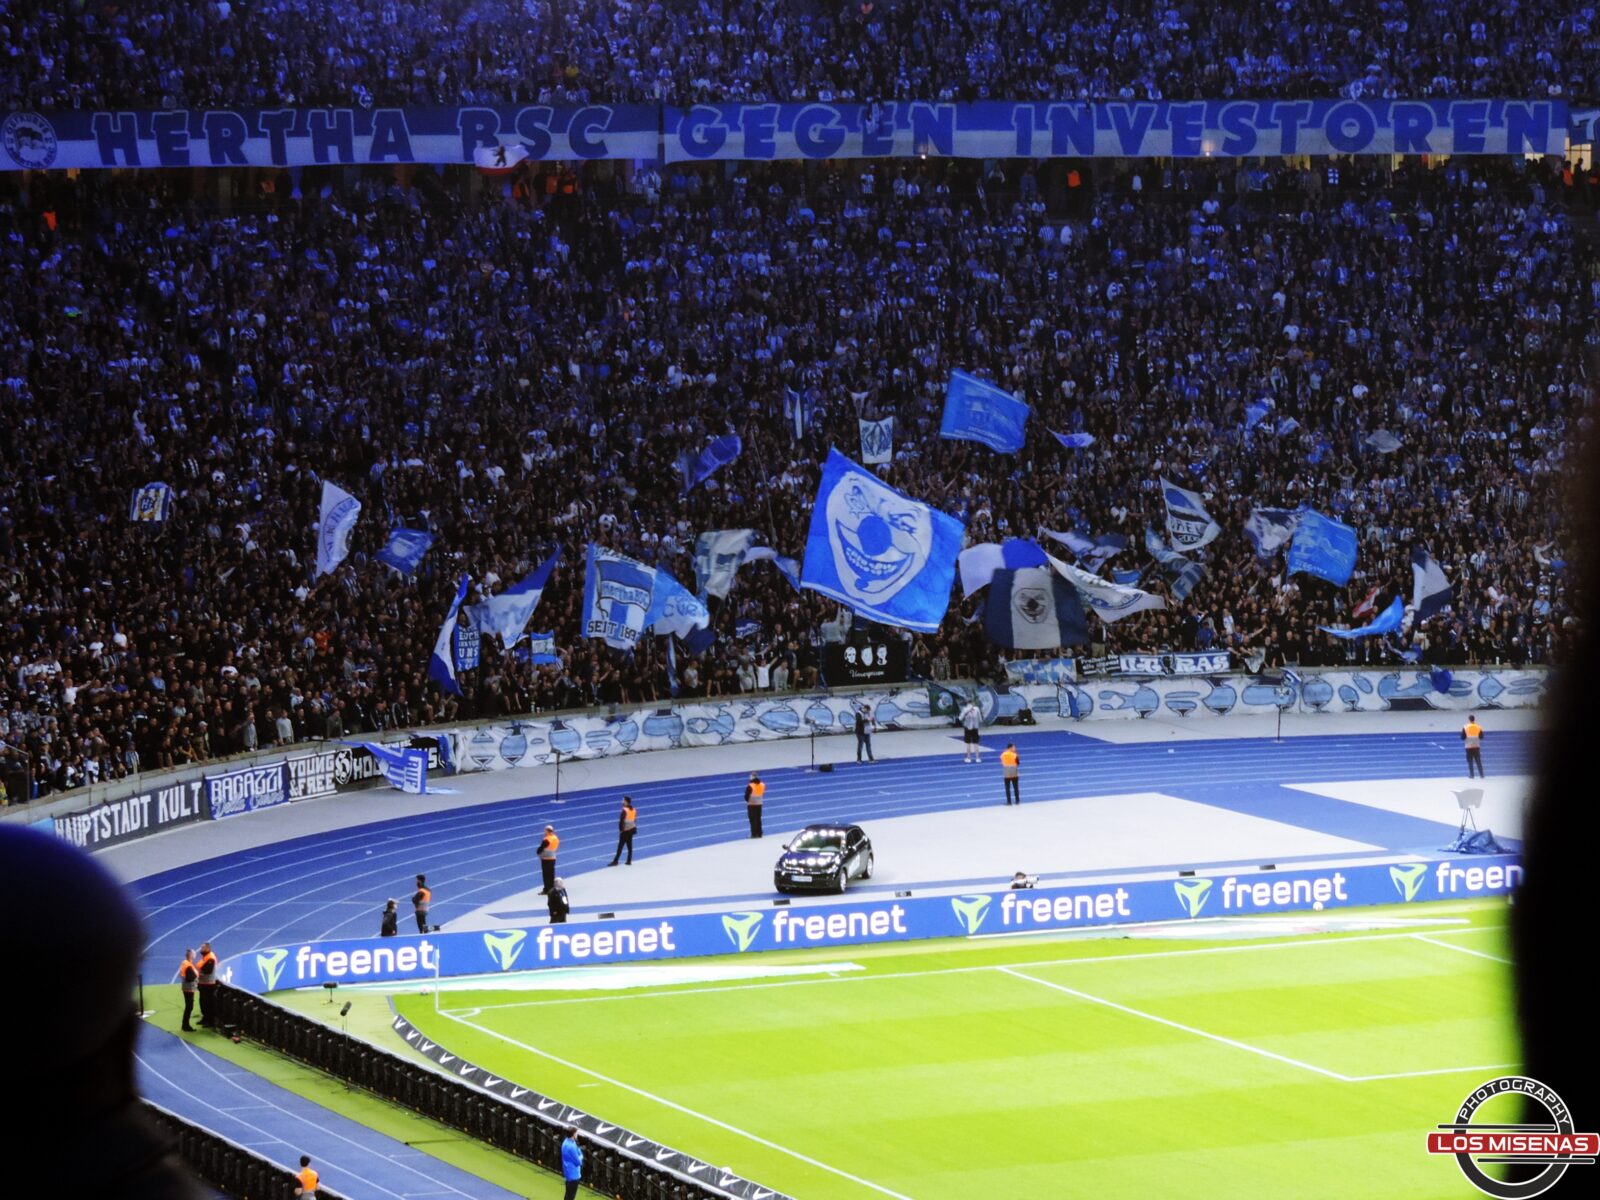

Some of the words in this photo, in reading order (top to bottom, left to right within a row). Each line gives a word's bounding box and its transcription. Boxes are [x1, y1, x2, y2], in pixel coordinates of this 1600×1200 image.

[91, 107, 414, 167] HERTHA
[457, 104, 612, 163] BSC
[676, 100, 958, 159] GEGEN
[1011, 99, 1554, 158] INVESTOREN
[587, 620, 617, 635] SEIT
[289, 754, 335, 779] YOUNG
[158, 781, 203, 824] KULT
[1001, 887, 1131, 925] freenet
[1222, 872, 1348, 908] freenet
[537, 920, 676, 961] freenet
[773, 904, 907, 943] freenet
[296, 939, 434, 980] freenet
